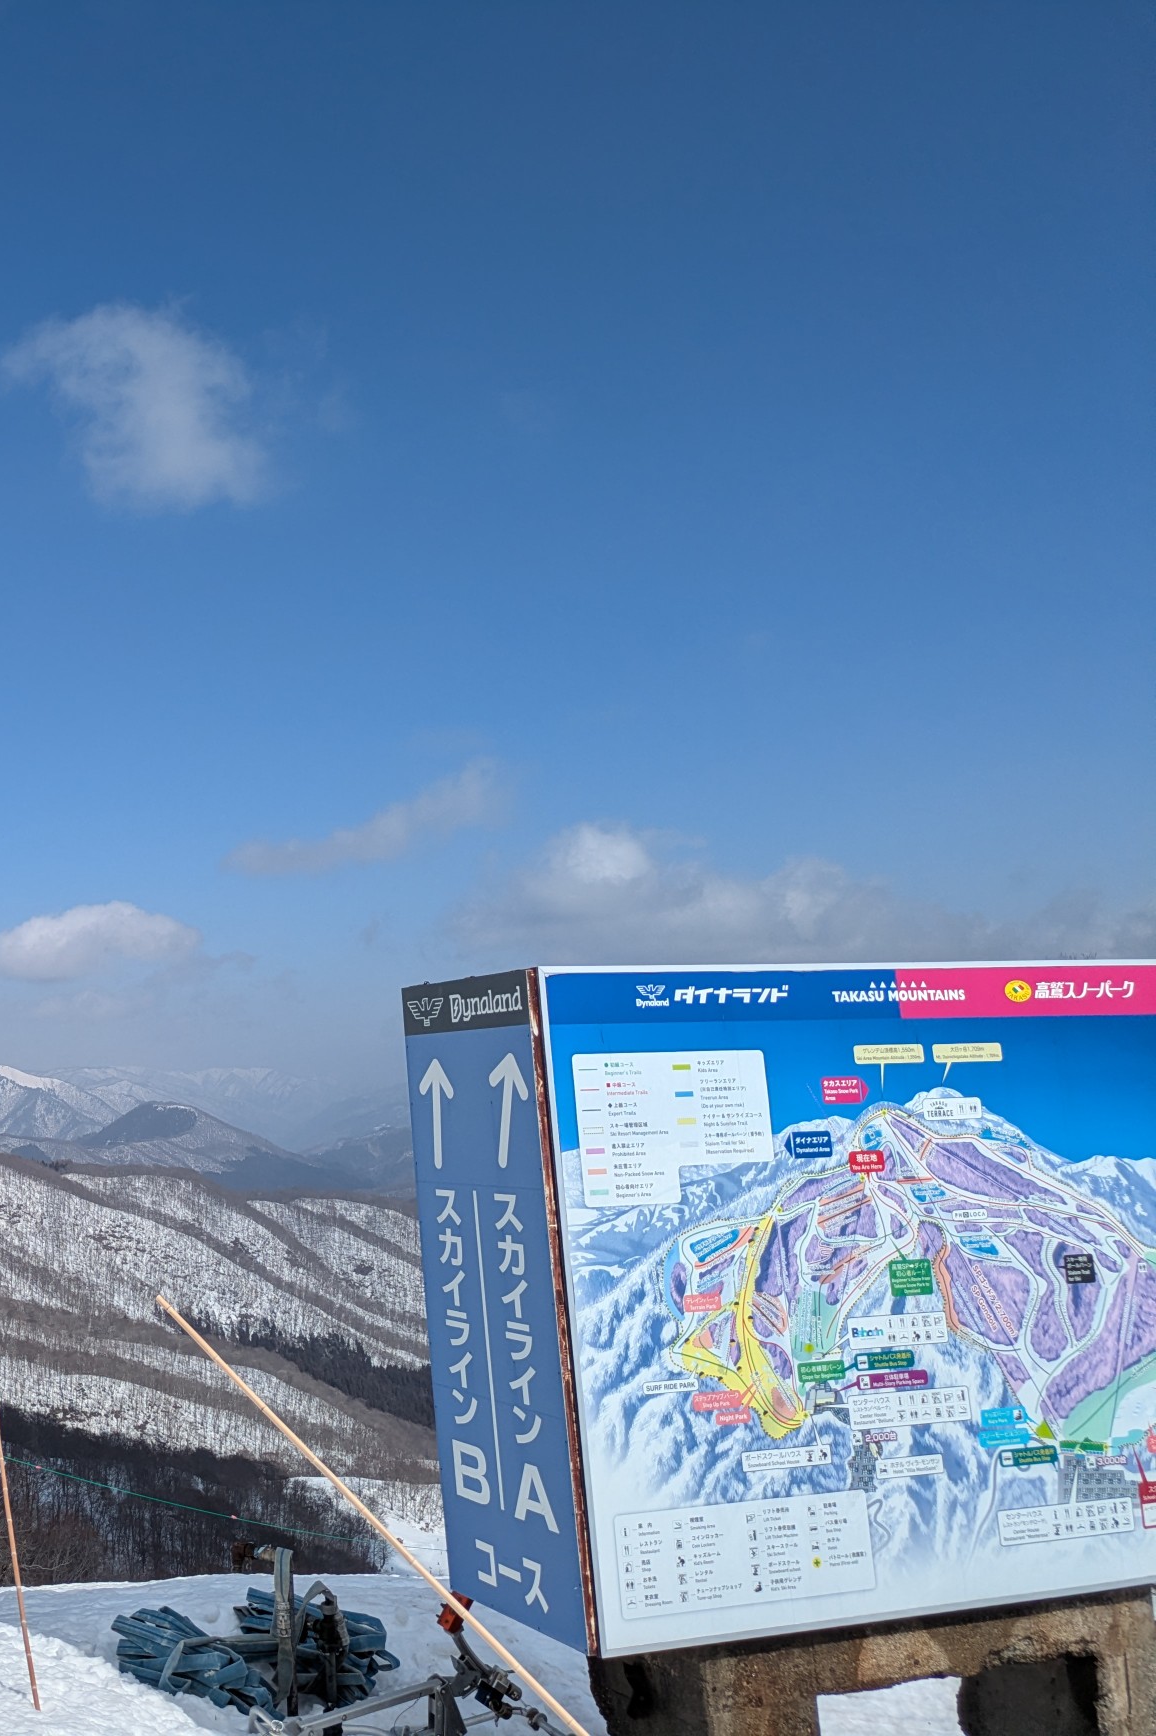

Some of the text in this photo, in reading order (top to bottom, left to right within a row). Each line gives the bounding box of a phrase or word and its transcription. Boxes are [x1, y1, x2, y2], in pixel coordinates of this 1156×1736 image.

[674, 985, 789, 1004] ダイナランド
[1035, 981, 1134, 999] 高鷲スノーパーク
[832, 989, 965, 1003] TAKASU MOUNTAINS
[449, 986, 522, 1022] Dynaland
[636, 998, 669, 1008] Dynaland
[927, 1109, 954, 1117] TERRACE
[795, 1136, 829, 1144] ダイナエリア
[856, 1154, 877, 1162] 現在地
[979, 1298, 997, 1331] Gondola
[646, 1384, 662, 1392] SURF
[663, 1383, 677, 1391] RIDE
[853, 1397, 890, 1405] センターハウス
[865, 1432, 897, 1442] 2,000台
[745, 1450, 801, 1461] ボードスクールハウス
[1097, 1456, 1127, 1465] 3,000台
[1006, 1510, 1042, 1520] センターハウス
[692, 1533, 724, 1541] コインロッカー
[639, 1539, 662, 1547] レストラン
[693, 1551, 721, 1559] キッズルーム
[475, 1538, 548, 1614] コース
